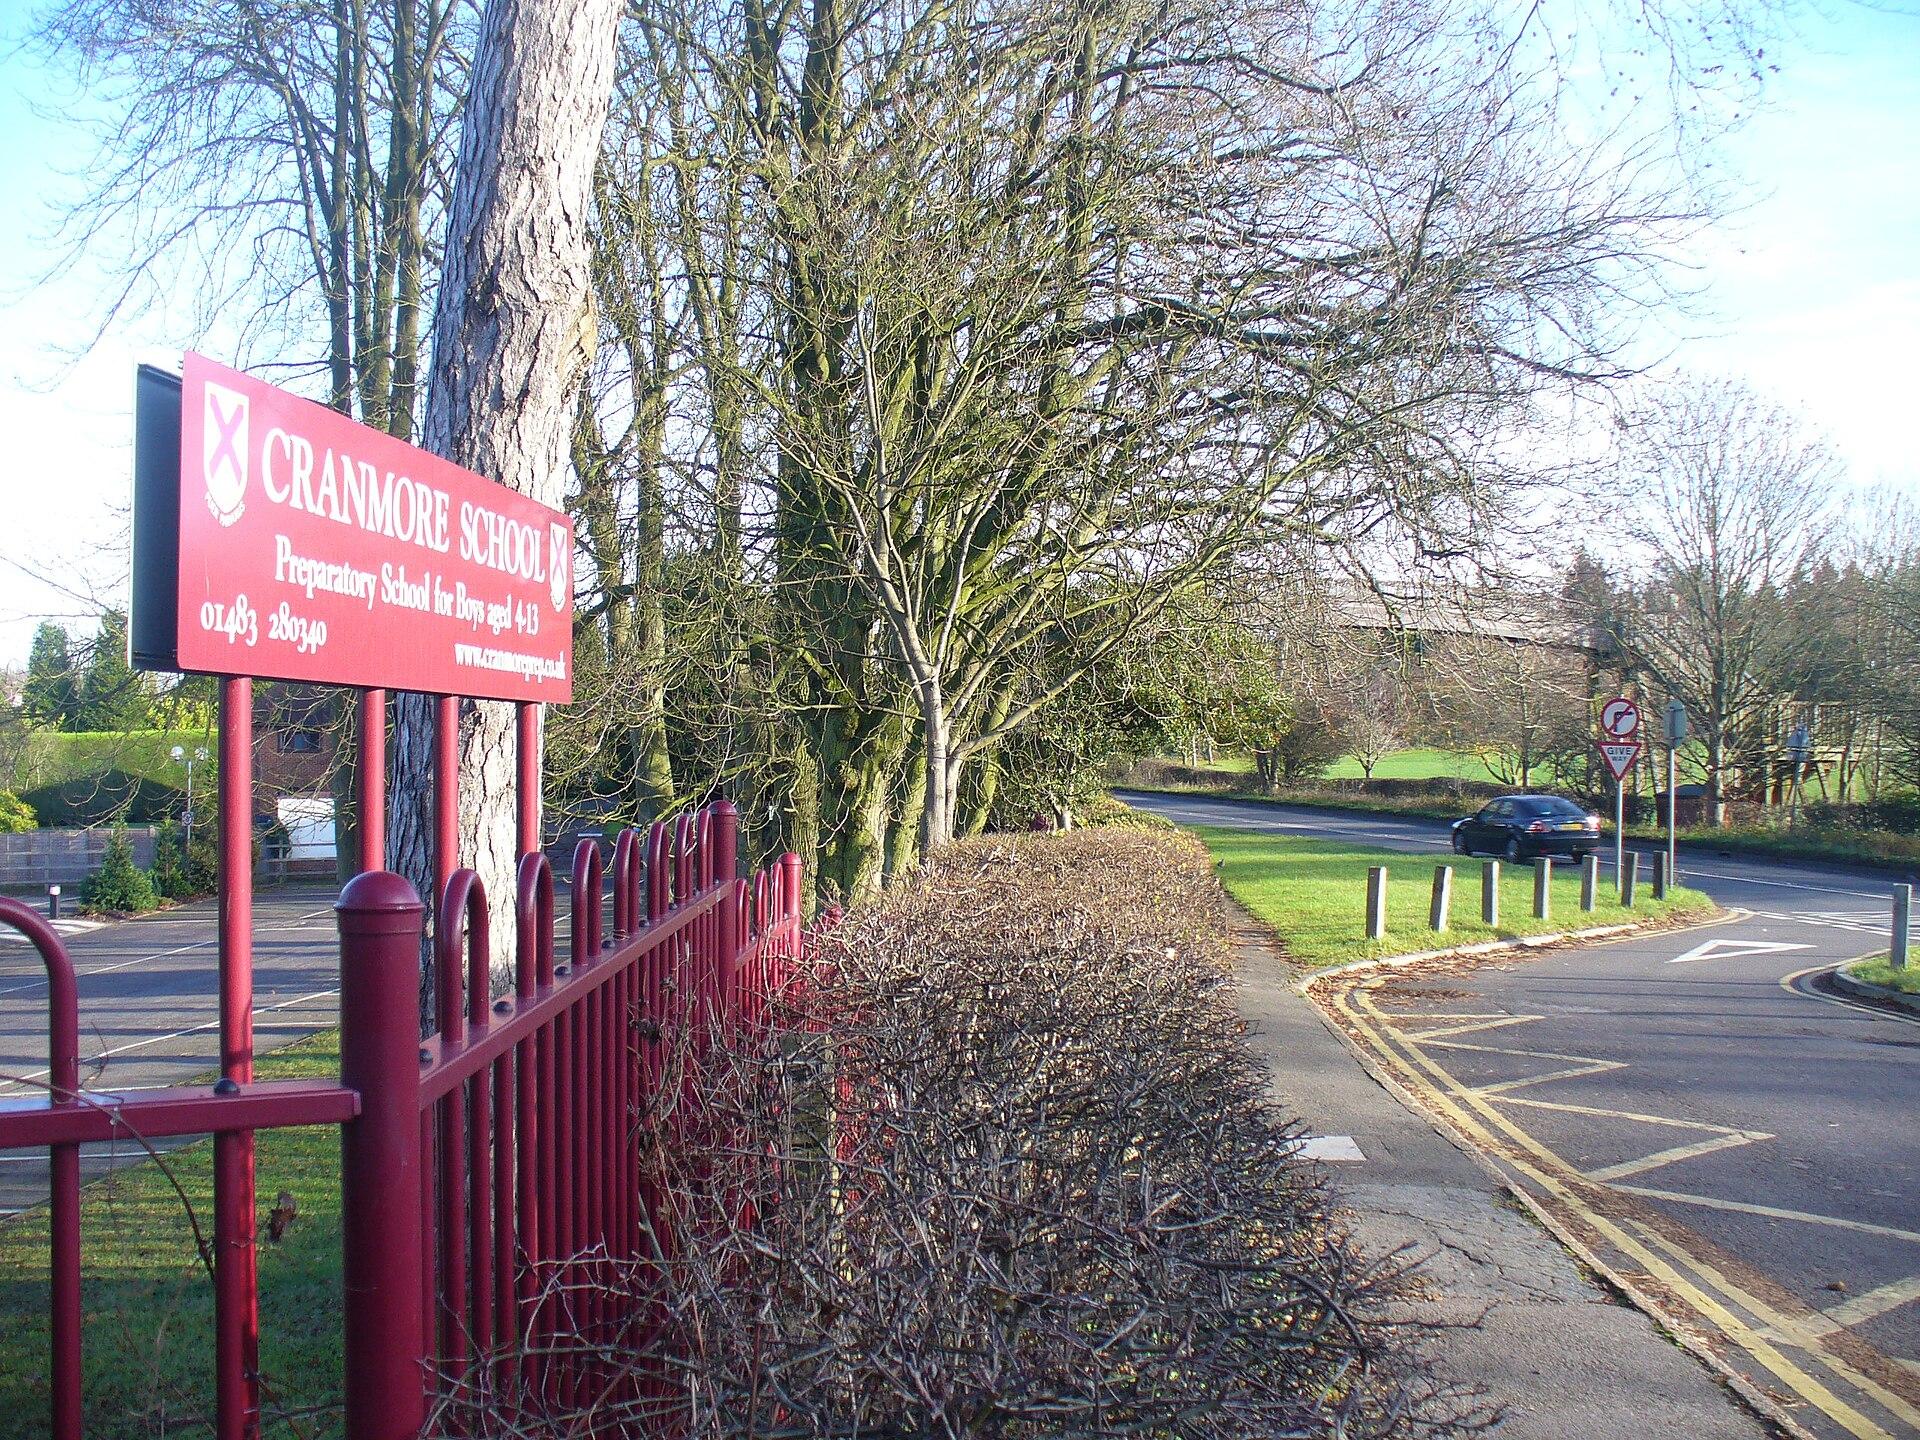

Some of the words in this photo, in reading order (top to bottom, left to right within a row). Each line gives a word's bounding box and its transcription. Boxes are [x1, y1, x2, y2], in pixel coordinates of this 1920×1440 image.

[261, 427, 450, 554] CRANMORE
[459, 501, 547, 584] SCHOOL
[274, 534, 377, 611] Preparatory
[381, 562, 432, 612] School
[434, 575, 455, 617] for
[455, 581, 485, 632] Boys
[486, 593, 512, 636] aged
[201, 593, 259, 647] 01483
[268, 601, 328, 655] 280340
[453, 642, 567, 684] www.cranmoreprep.co.uk
[1607, 746, 1632, 755] GIVE
